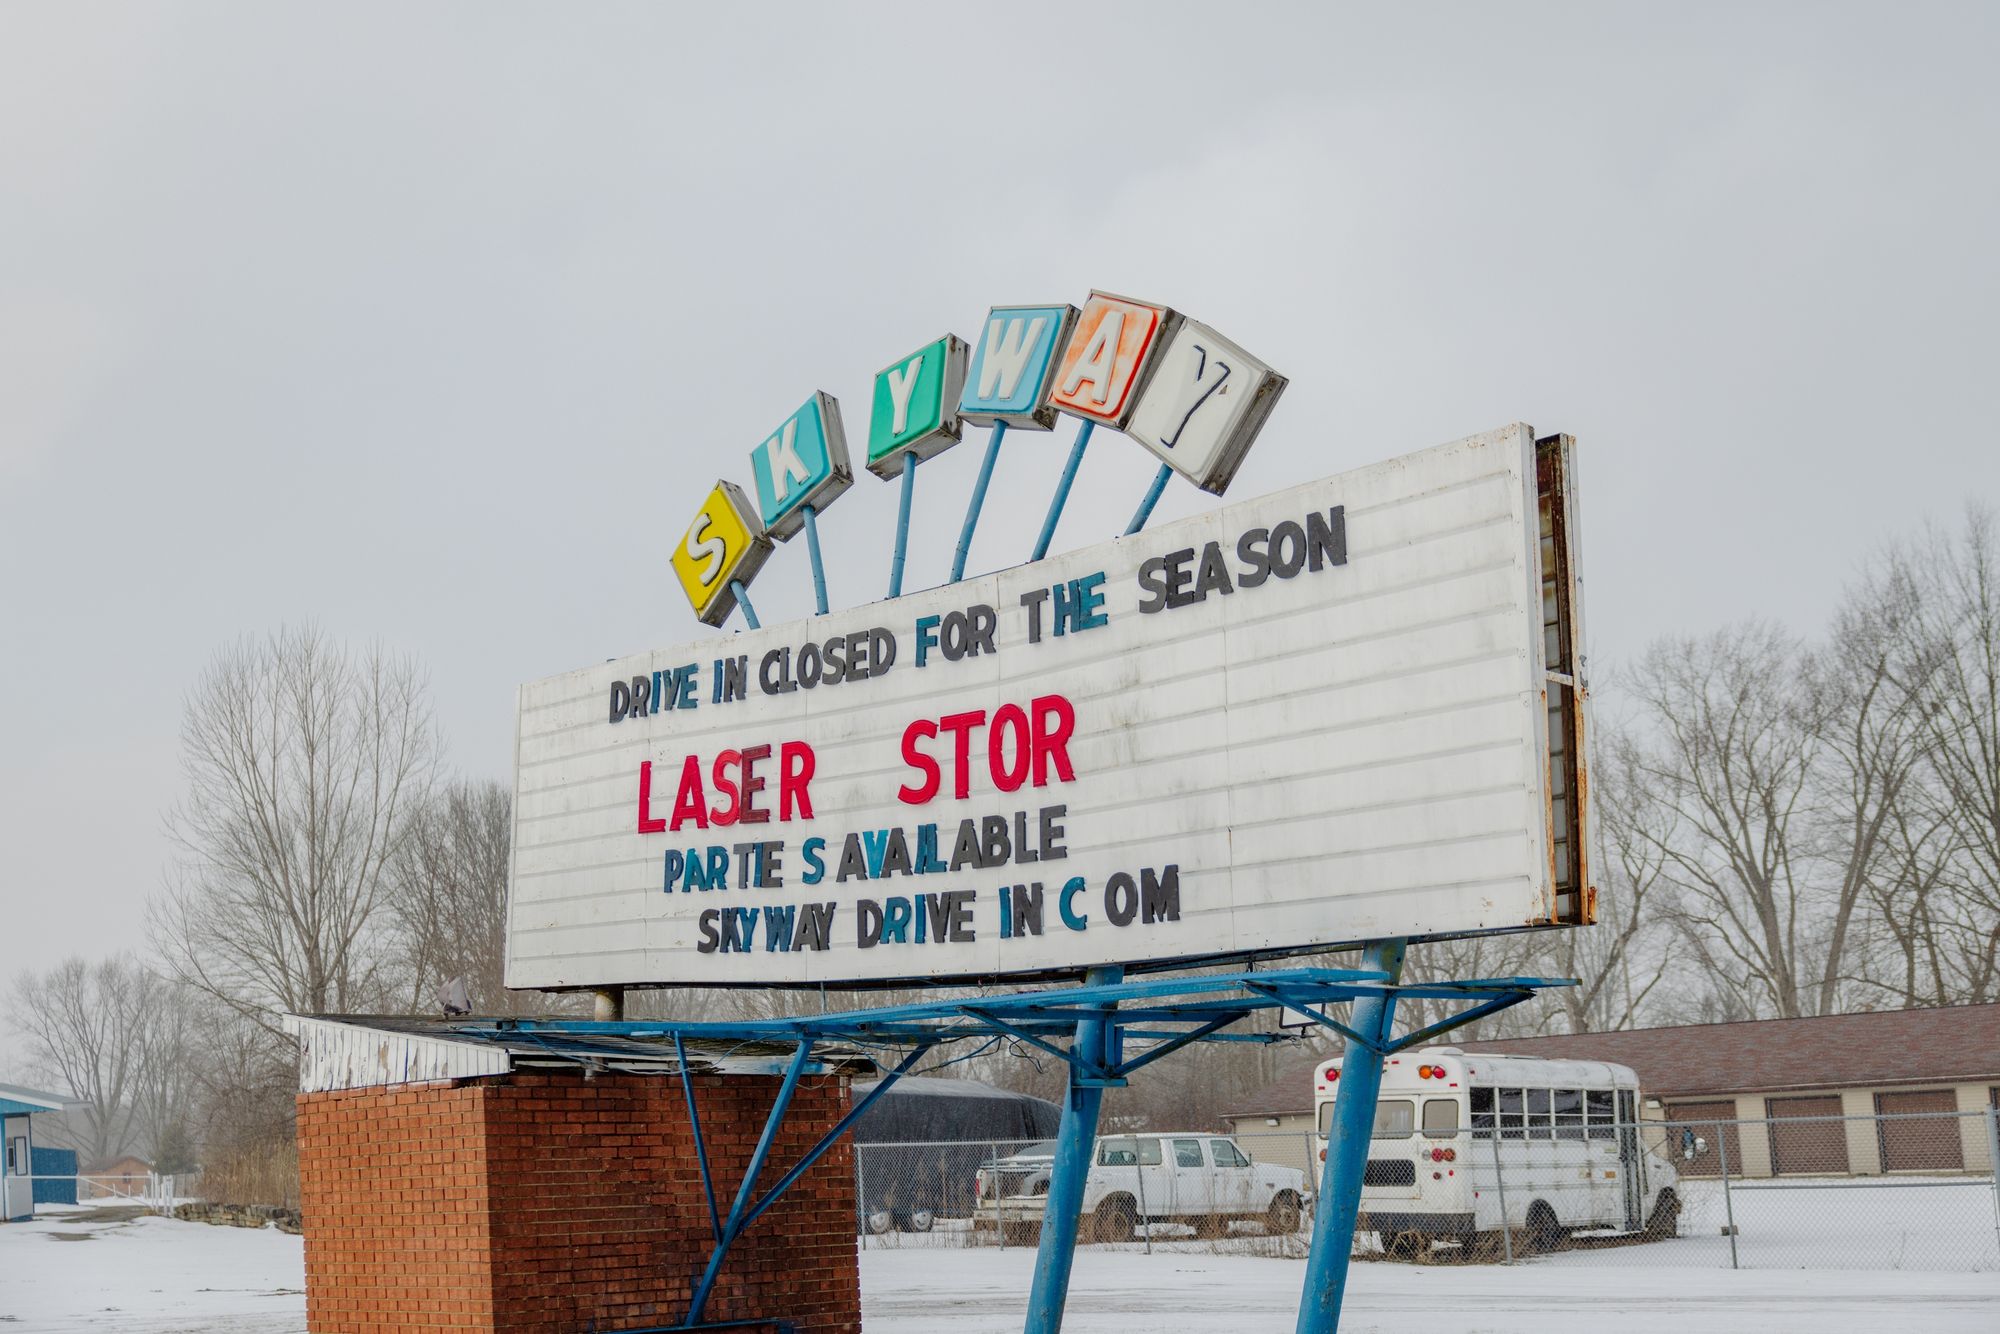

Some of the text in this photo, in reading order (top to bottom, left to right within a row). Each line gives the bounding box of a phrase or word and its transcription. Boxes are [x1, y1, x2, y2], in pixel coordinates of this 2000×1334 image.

[687, 310, 1231, 587] SKYWAY
[609, 505, 1347, 723] DRIVE IN CLOSED FOR THE SEASON
[638, 694, 1076, 834] LASER STOR
[836, 804, 1067, 883] AVAILABLE
[697, 902, 836, 953] SKYWAY
[857, 890, 976, 948] DRIVE
[999, 882, 1044, 939] IN
